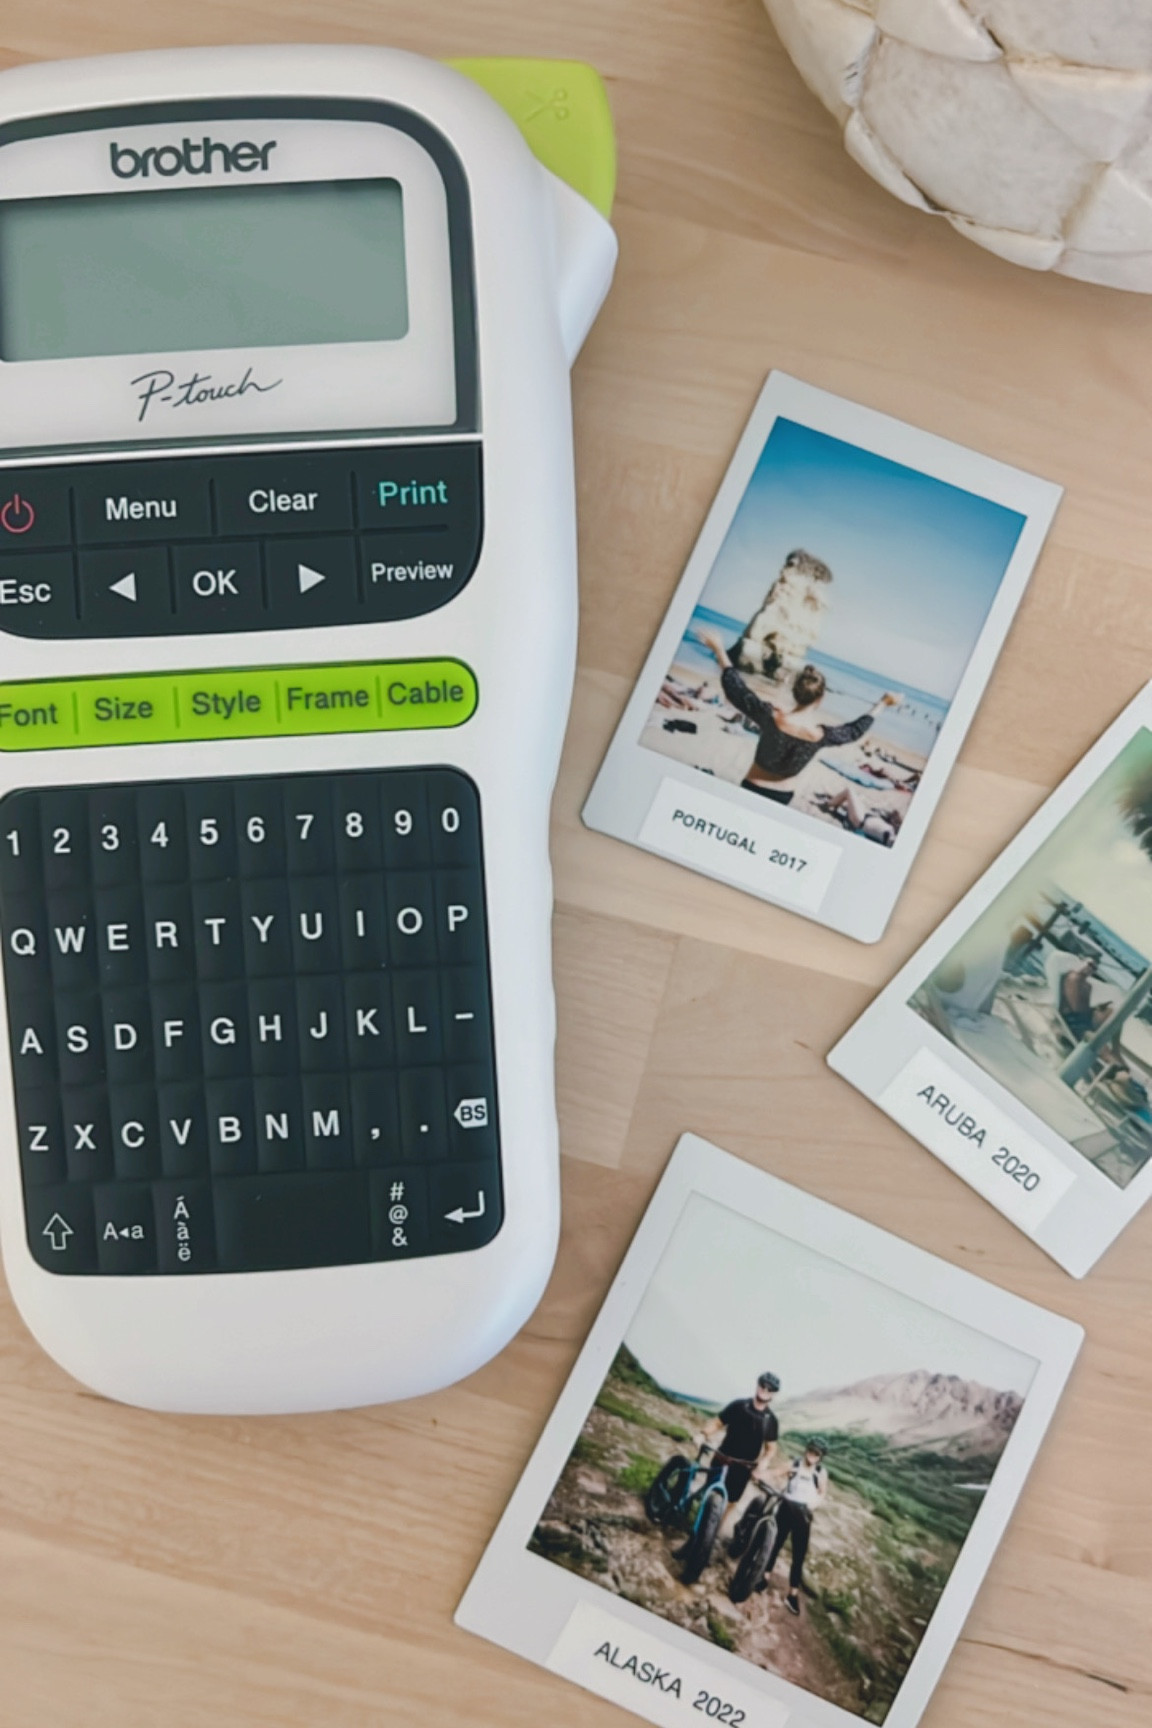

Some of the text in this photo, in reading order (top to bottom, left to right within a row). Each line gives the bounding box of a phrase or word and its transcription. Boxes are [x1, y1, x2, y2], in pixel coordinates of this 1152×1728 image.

[109, 136, 277, 179] brother
[130, 367, 284, 422] P-touch
[248, 489, 318, 513] Clear
[378, 480, 448, 507] Print
[105, 497, 177, 521] Menu
[192, 569, 238, 596] OK
[371, 560, 454, 582] Preview
[0, 579, 51, 604] Esc
[192, 689, 262, 720] Style
[287, 686, 370, 711] Frame
[387, 679, 464, 706] Cable
[0, 703, 59, 727] Font
[94, 696, 154, 722] Size
[6, 830, 19, 856] 1
[53, 828, 71, 854] 2
[101, 824, 119, 851] 3
[150, 822, 169, 848] 4
[200, 818, 219, 845] 5
[247, 816, 265, 843] 6
[296, 814, 314, 840] 7
[346, 812, 364, 838] 8
[394, 809, 412, 835] 9
[672, 809, 808, 872] PORTUGAL 2017
[10, 905, 468, 955] Q W E R T Y U I O P
[20, 1028, 43, 1055] A
[67, 1025, 89, 1053] S
[114, 1023, 137, 1050] D
[164, 1020, 183, 1047] F
[210, 1017, 236, 1045] G
[258, 1014, 282, 1042] H
[310, 1011, 327, 1039] J
[356, 1008, 379, 1036] K
[407, 1006, 427, 1033] L
[28, 1125, 49, 1151] Z
[74, 1124, 96, 1150] X
[121, 1121, 145, 1148] C
[170, 1119, 191, 1145] V
[218, 1116, 241, 1143] B
[265, 1113, 289, 1140] N
[312, 1109, 340, 1137] M
[460, 1104, 486, 1122] BS
[915, 1084, 1041, 1192] ARUBA 2020
[592, 1641, 746, 1728] ALASKA 2022
